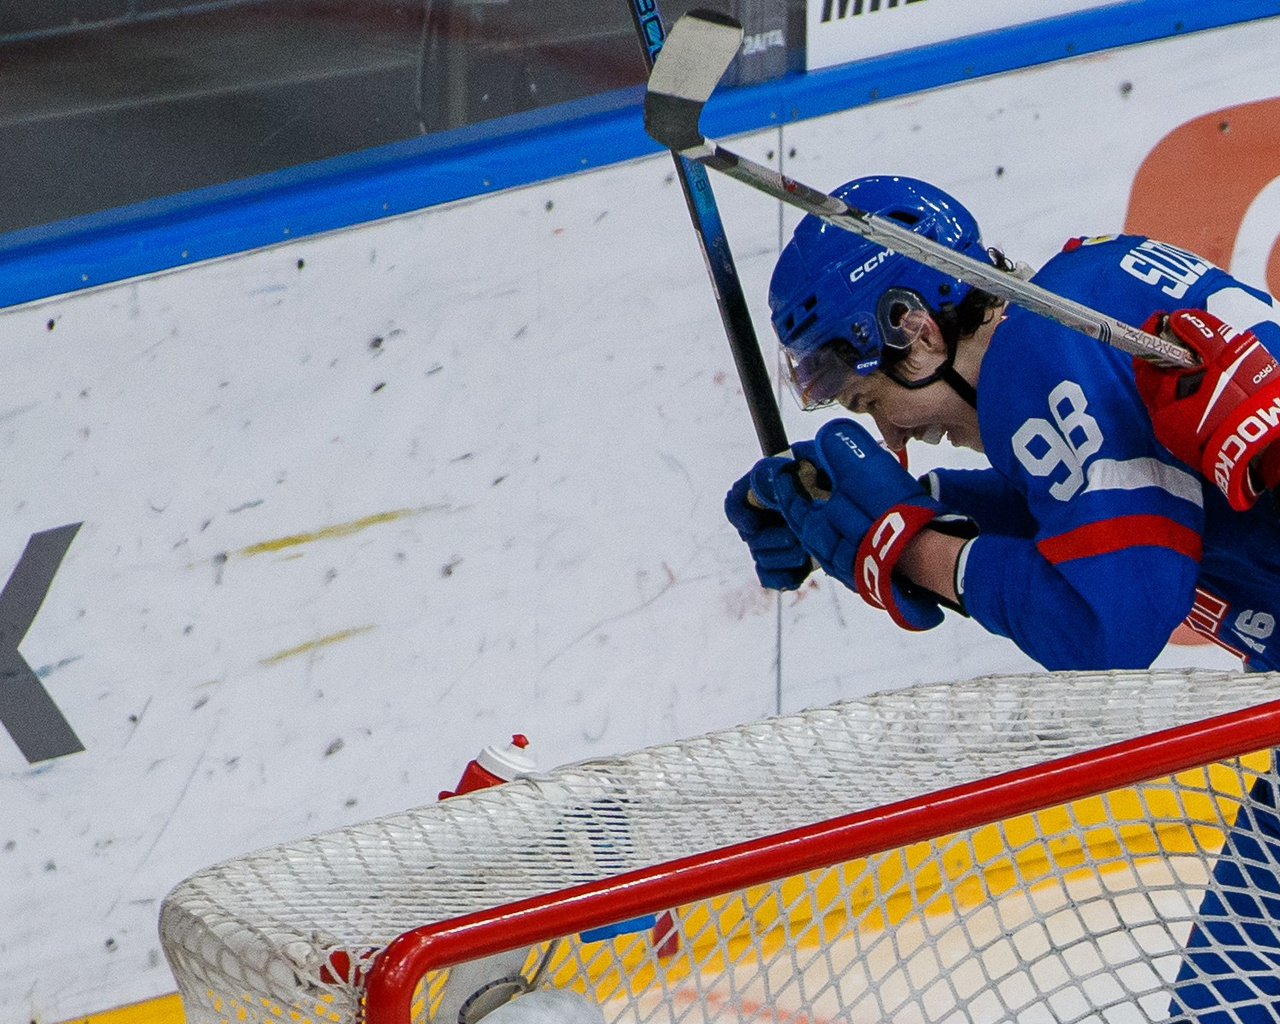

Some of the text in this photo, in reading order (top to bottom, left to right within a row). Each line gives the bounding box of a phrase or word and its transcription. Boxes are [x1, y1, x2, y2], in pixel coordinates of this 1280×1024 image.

[850, 247, 895, 282] CCM
[1011, 379, 1104, 502] 98
[863, 511, 906, 608] CC
